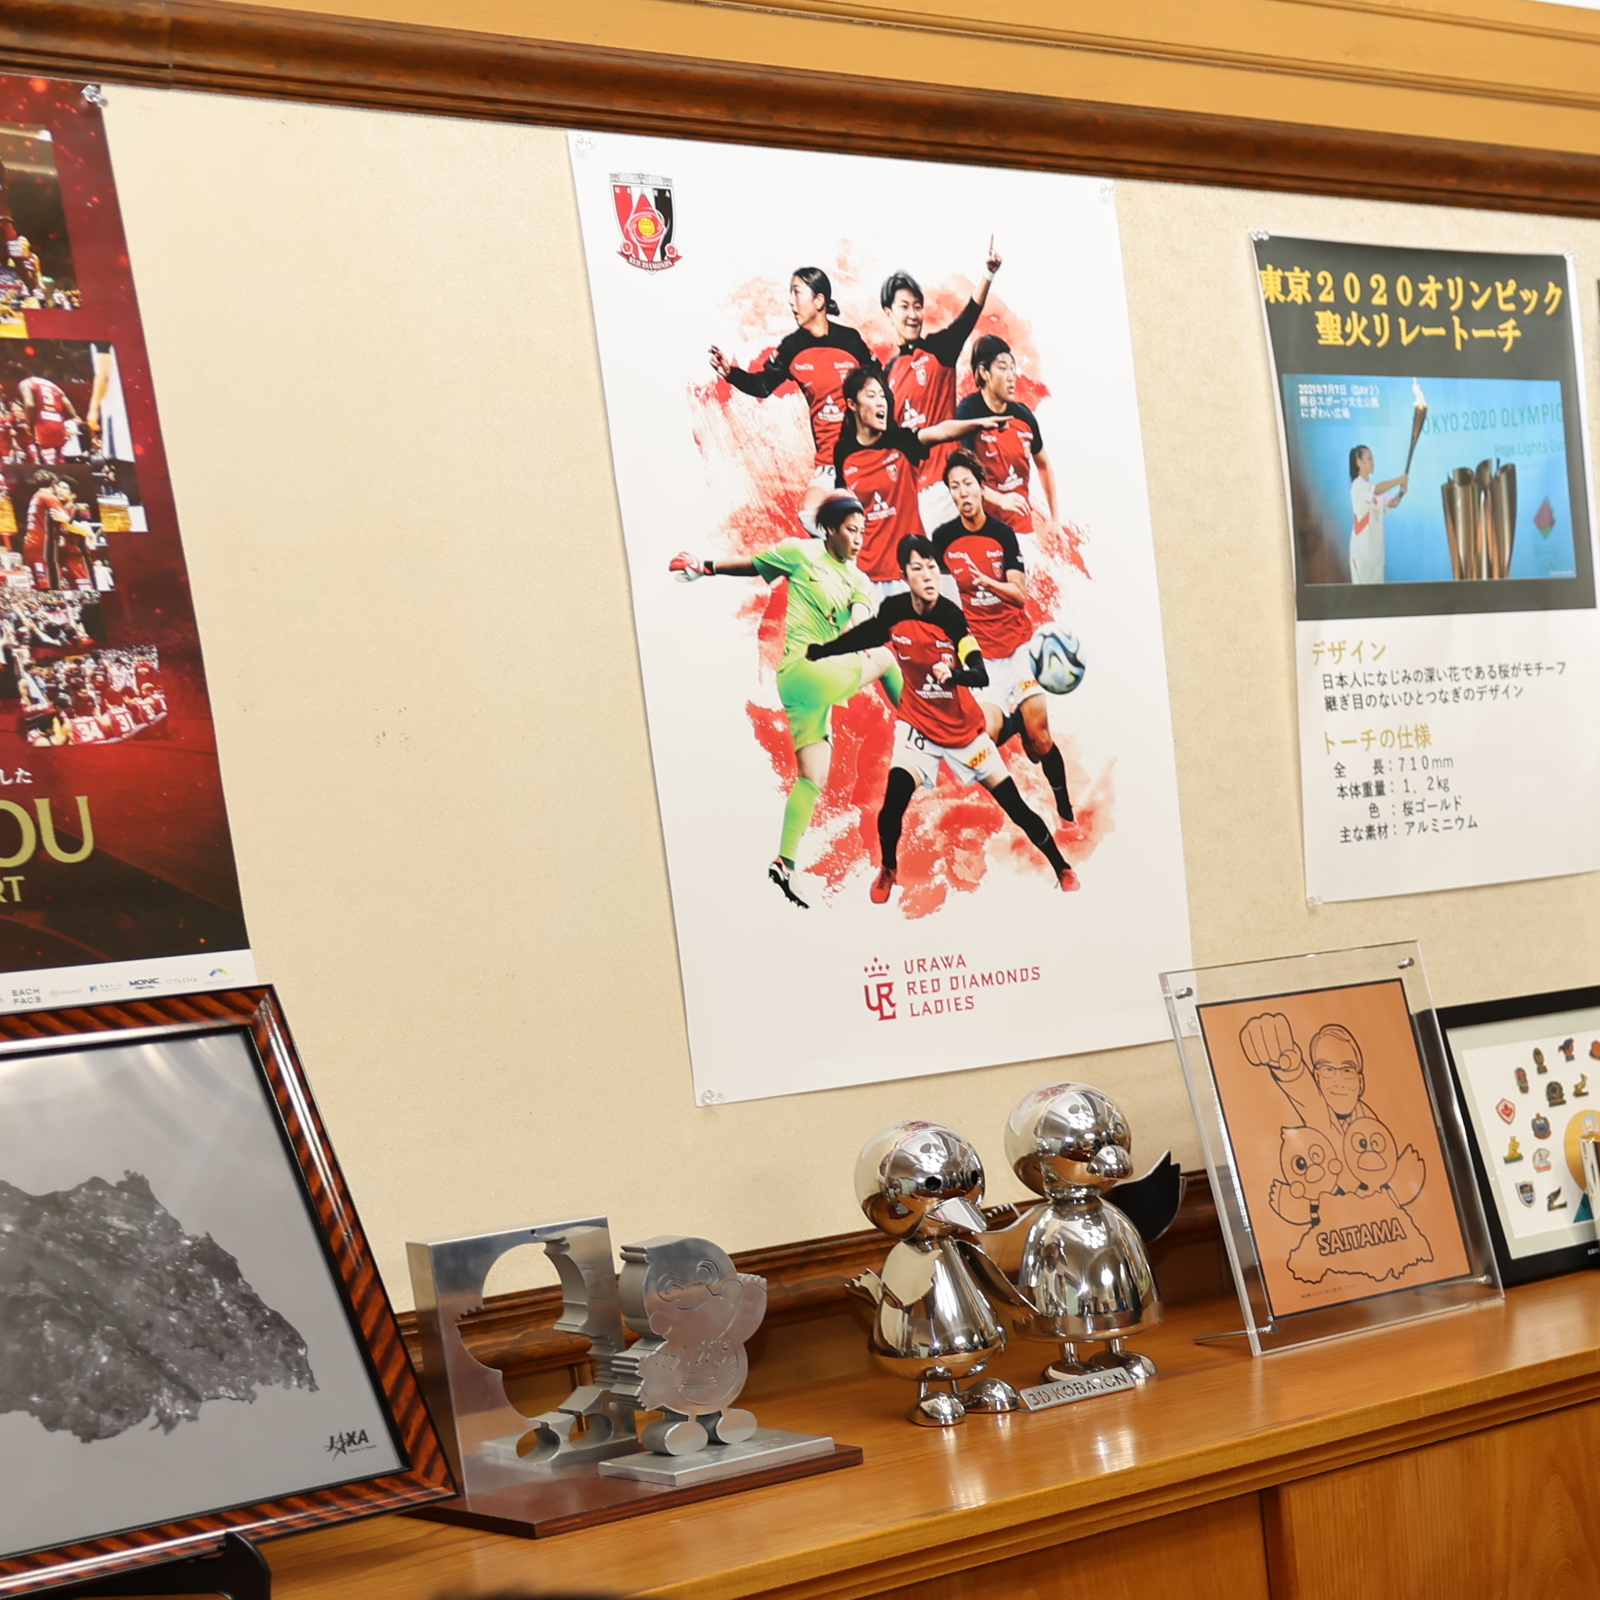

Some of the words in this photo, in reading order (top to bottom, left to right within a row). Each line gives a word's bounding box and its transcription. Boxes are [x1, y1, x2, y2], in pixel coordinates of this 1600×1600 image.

[1259, 264, 1563, 316] 東京2020オリンピック
[1315, 310, 1522, 352] 聖火リレートーチ
[1415, 415, 1458, 436] OKYO
[1463, 409, 1497, 431] 2020
[1311, 641, 1387, 667] デザイン
[1322, 661, 1567, 690] 日本人になじみの深い花である桜がモチーフ
[1324, 684, 1524, 713] 継ぎ目のないひとつなぎのデザイン
[1324, 723, 1432, 755] トーチの仕様
[0, 876, 25, 903] T
[904, 954, 967, 975] URAWA
[12, 988, 40, 997] EACH
[907, 978, 940, 995] RED
[950, 966, 1041, 991] DIAMONDS
[910, 996, 974, 1017] LADIES
[1316, 1217, 1407, 1256] SAITAMA
[1052, 1372, 1128, 1400] KOBATON
[323, 1429, 369, 1459] JAXA
